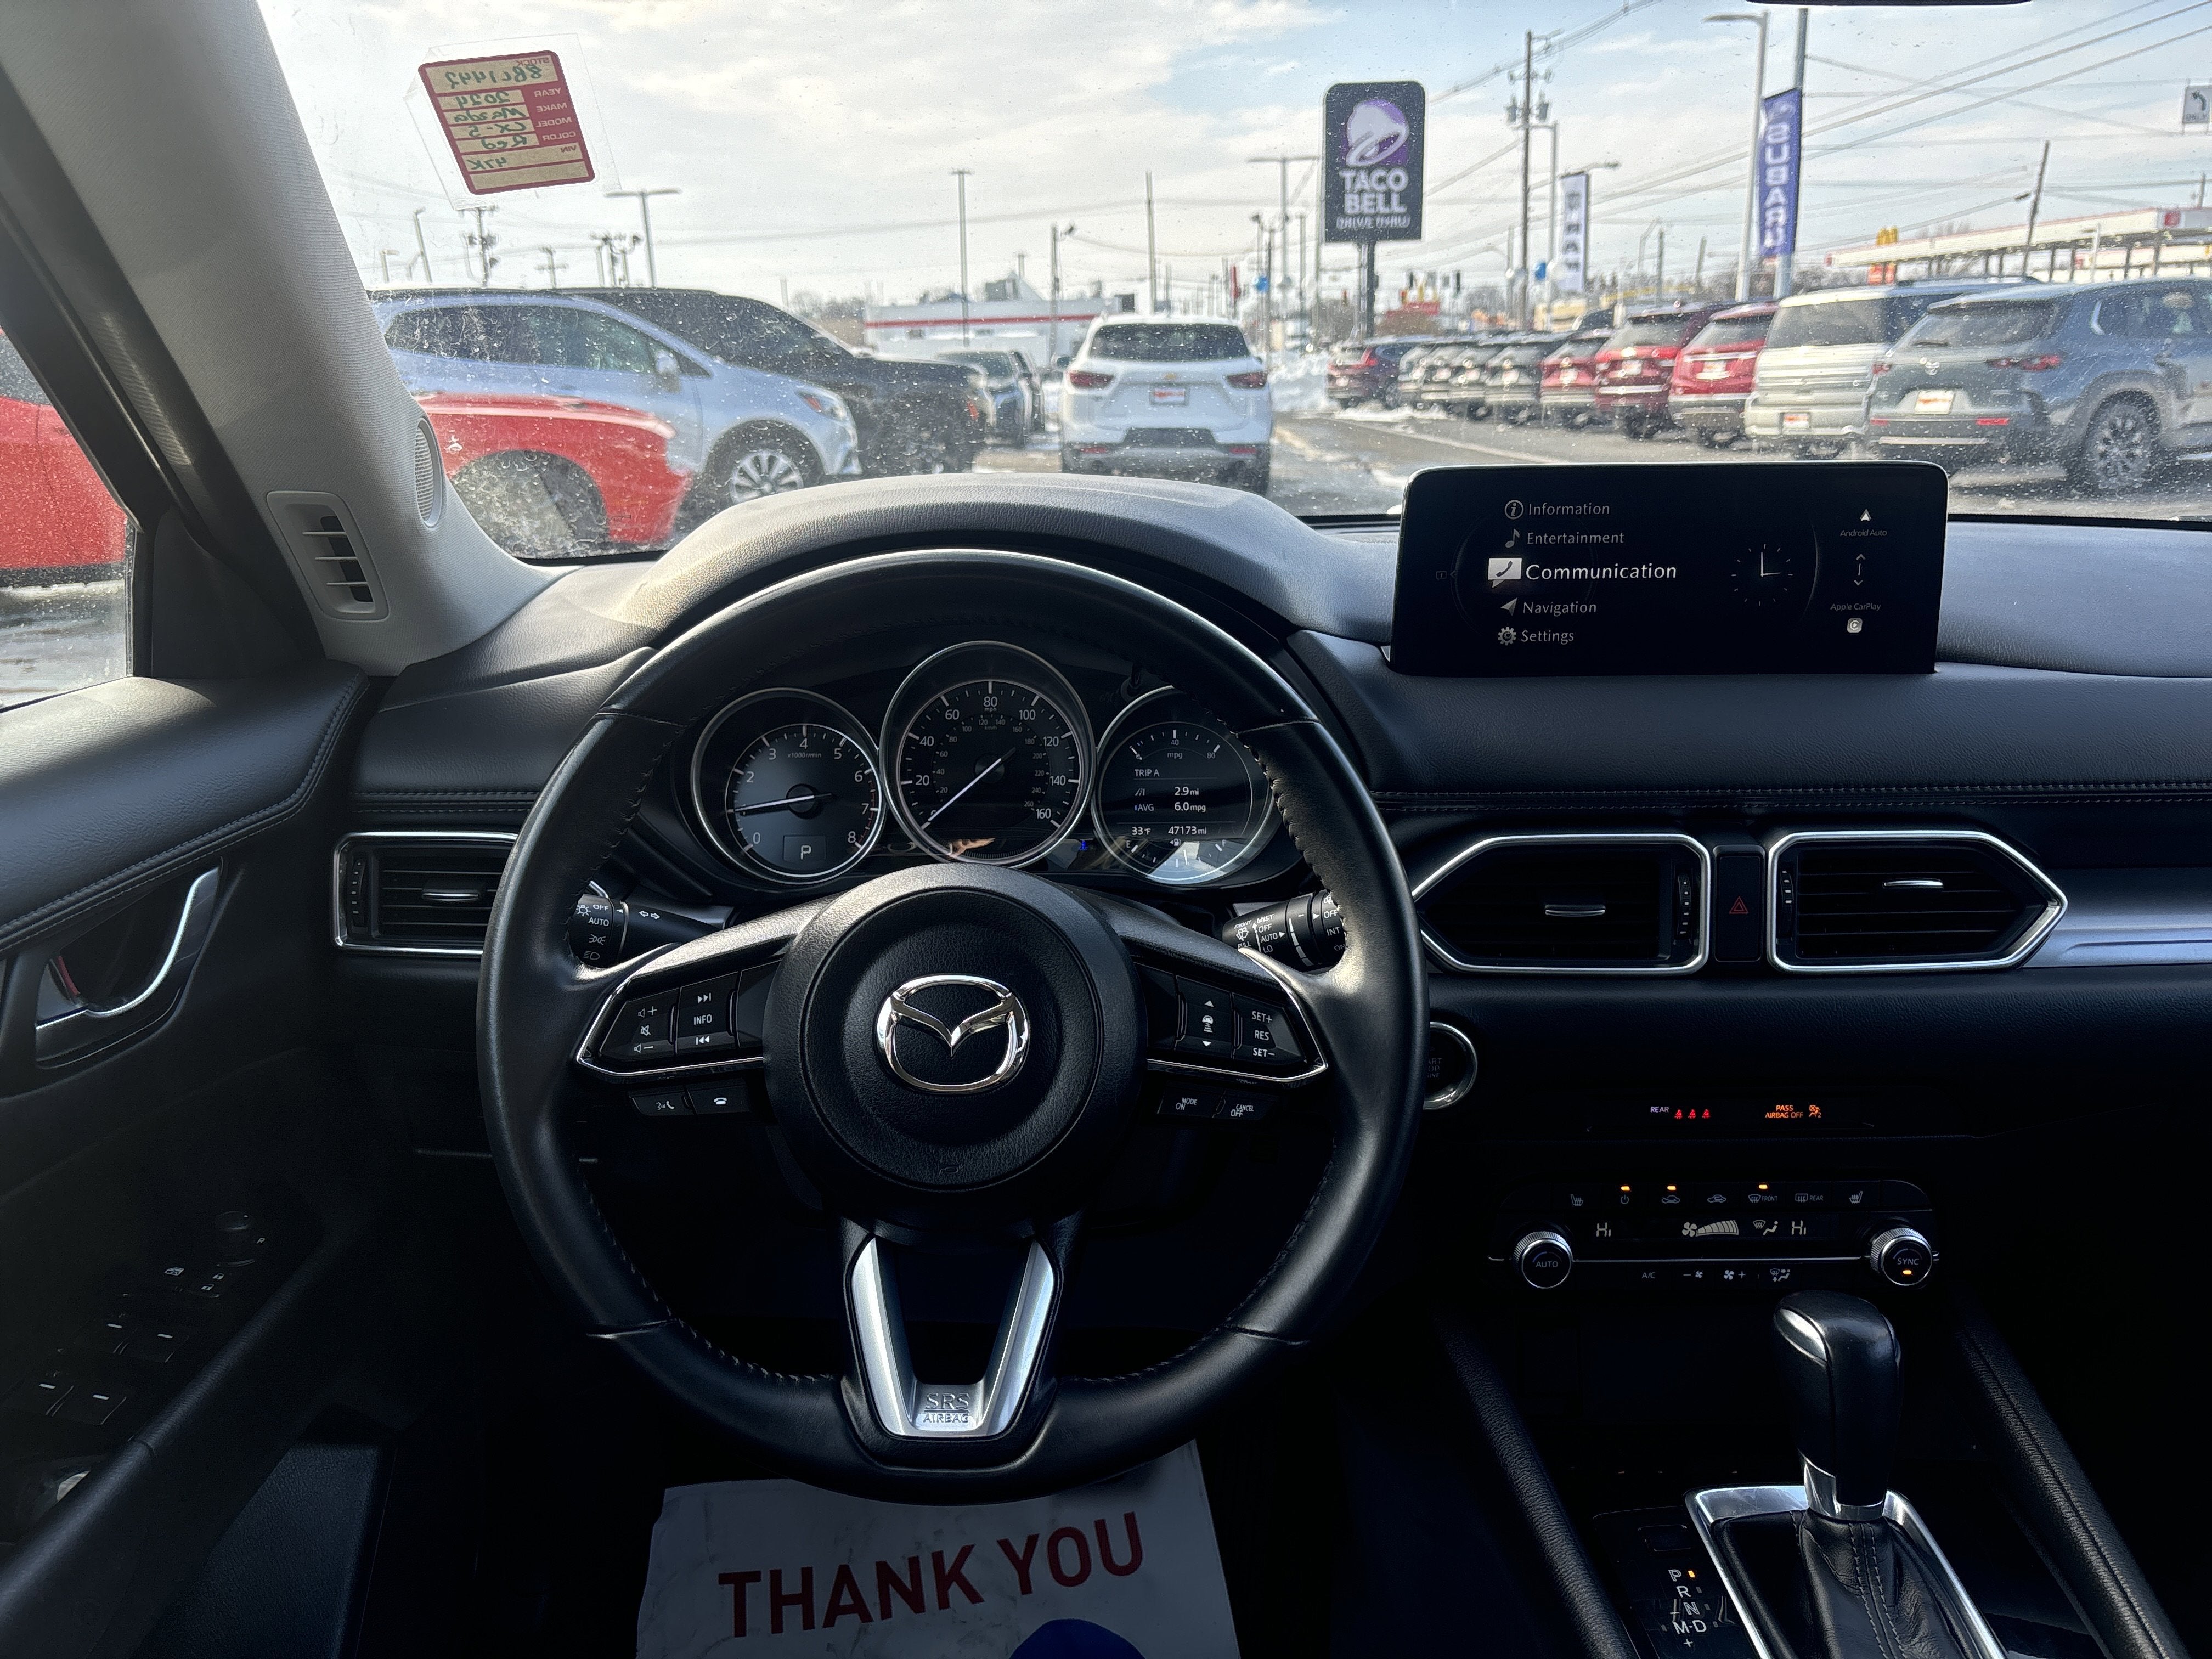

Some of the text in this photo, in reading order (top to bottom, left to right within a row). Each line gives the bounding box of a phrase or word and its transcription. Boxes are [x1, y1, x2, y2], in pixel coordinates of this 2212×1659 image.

[1339, 167, 1409, 192] TACO
[1345, 193, 1407, 213] BELL
[1528, 502, 1610, 516] Information
[1527, 532, 1624, 545] Entertainment
[1839, 529, 1869, 537] Android
[1526, 563, 1677, 580] Communication
[1523, 601, 1596, 617] Navigation
[1830, 603, 1881, 612] Apple CarPlay
[1521, 630, 1575, 645] Settings
[983, 696, 998, 707] 80
[945, 709, 960, 720] 60
[1019, 709, 1036, 720] 100
[799, 738, 808, 749] 4
[919, 735, 934, 747] 40
[1043, 736, 1059, 747] 120
[769, 748, 777, 760] 3
[834, 748, 842, 760] 5
[746, 771, 754, 783] 2
[854, 770, 863, 782] 6
[916, 775, 929, 786] 20
[1050, 775, 1066, 786] 140
[1175, 787, 1189, 795] 2.9
[861, 803, 870, 815] 7
[1175, 802, 1189, 811] 6.0
[1036, 808, 1051, 819] 160
[1168, 826, 1197, 835] 47173
[753, 832, 761, 844] 0
[848, 831, 856, 843] 8
[800, 845, 811, 860] P
[1257, 914, 1274, 924] MIST
[1323, 910, 1338, 919] OFF
[588, 917, 609, 927] AUTO
[1234, 919, 1252, 929] FRONT
[1258, 923, 1272, 933] OFF
[1327, 927, 1340, 936] INT
[1261, 933, 1278, 943] AUTO
[1238, 941, 1251, 949] PULL
[1263, 945, 1273, 953] LO
[693, 1014, 713, 1025] INFO
[1254, 1030, 1269, 1041] RES
[1182, 1097, 1197, 1105] MODE
[1176, 1103, 1186, 1111] ON
[1236, 1104, 1254, 1112] CANCEL
[1897, 1257, 1919, 1266] SYNC
[926, 1392, 969, 1410] SRS
[923, 1413, 969, 1423] AIRBAG
[718, 1511, 1144, 1638] THANK YOU
[1668, 1569, 1682, 1582] P
[1676, 1585, 1692, 1598] R
[1683, 1601, 1700, 1616] N
